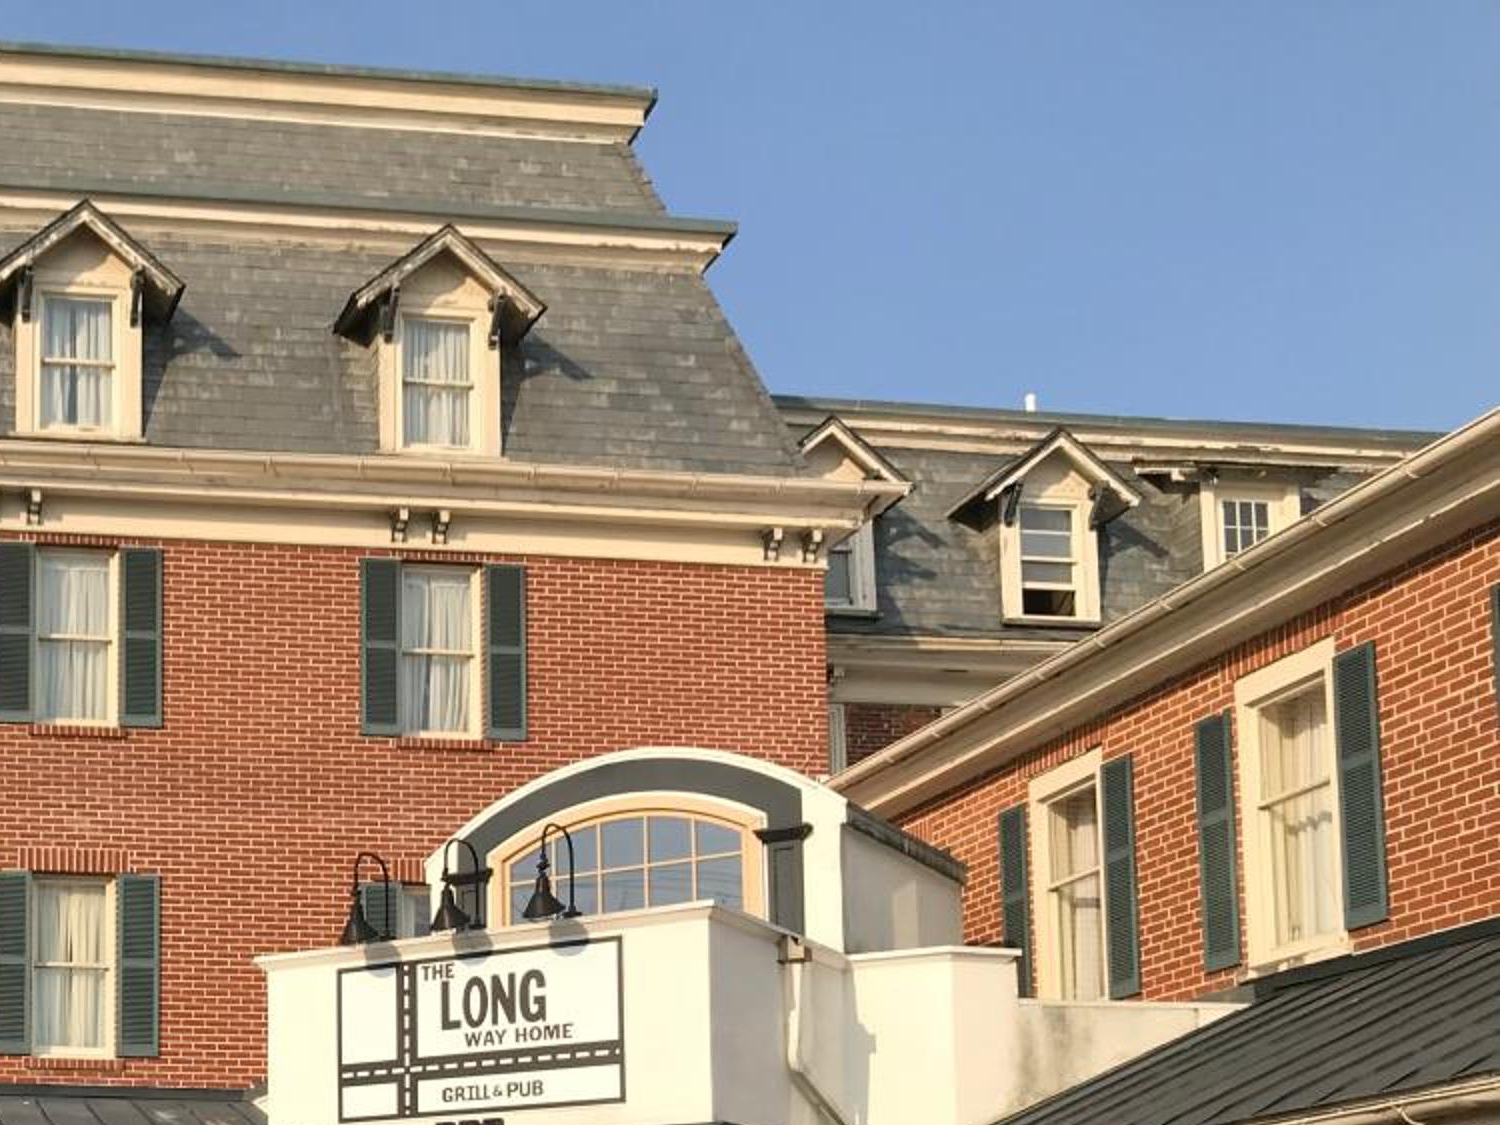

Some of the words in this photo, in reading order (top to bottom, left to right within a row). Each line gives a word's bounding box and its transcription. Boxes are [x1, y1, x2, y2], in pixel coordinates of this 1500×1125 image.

[422, 963, 455, 982] THE
[440, 969, 547, 1031] LONG
[464, 1029, 507, 1047] WAY
[515, 1023, 573, 1043] HOME
[442, 1084, 491, 1103] GRILL
[492, 1083, 504, 1098] &
[506, 1079, 544, 1098] PUB
